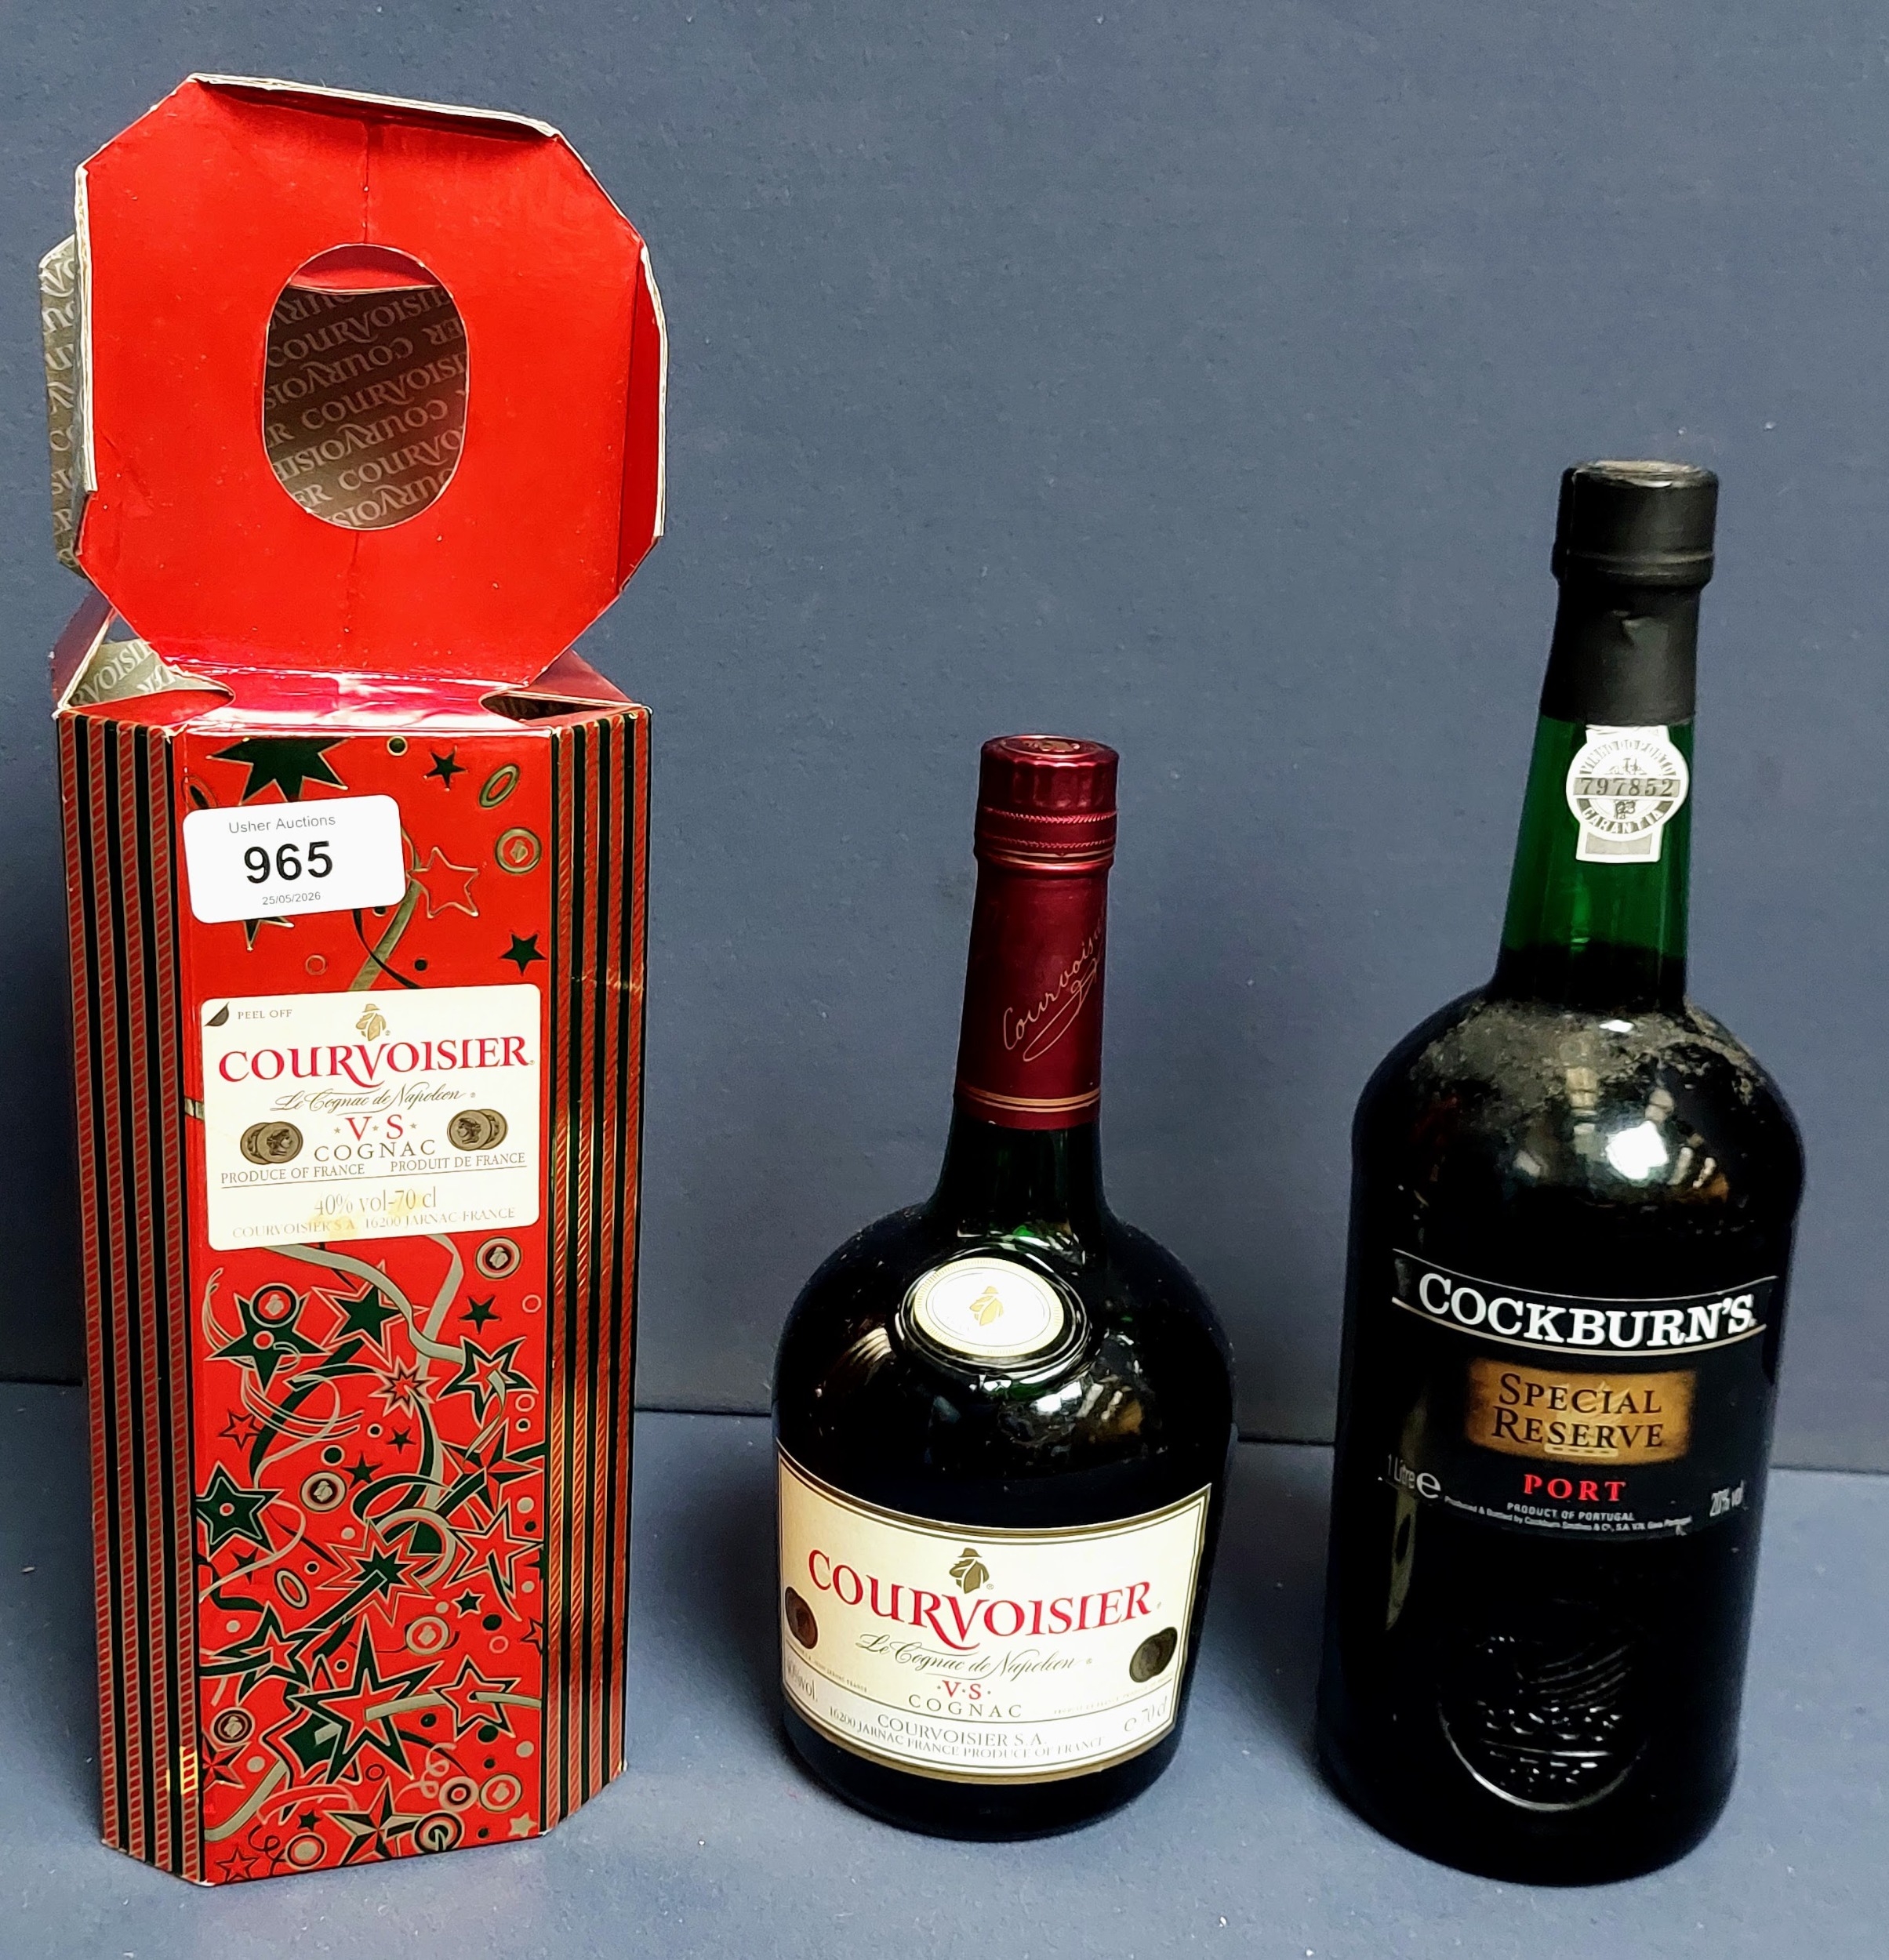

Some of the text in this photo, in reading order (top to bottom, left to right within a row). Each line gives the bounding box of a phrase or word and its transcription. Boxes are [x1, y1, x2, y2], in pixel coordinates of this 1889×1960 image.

[1581, 777, 1673, 797] 797852
[229, 815, 336, 833] Usher Auctions
[244, 840, 333, 884] 965
[262, 891, 321, 906] 25/05/2026
[237, 1009, 293, 1020] PEEL OFF
[219, 1036, 529, 1088] COURVOISIER
[270, 1091, 303, 1112] Le
[308, 1087, 372, 1116] Cognac
[372, 1089, 393, 1105] de
[314, 1139, 436, 1163] COGNAC
[391, 1152, 525, 1173] PRODUIT DE FRANCE
[220, 1163, 365, 1185] PRODUCE OF FRANCE
[314, 1192, 354, 1216] 40%
[421, 1186, 437, 1208] cl
[232, 1221, 330, 1239] COURVOISIER
[365, 1216, 401, 1229] 16200
[1419, 1272, 1755, 1348] COCKBURN'S
[1498, 1372, 1662, 1414] SPECIAL
[1491, 1406, 1664, 1449] RESERVE
[1523, 1474, 1626, 1502] PORT
[1507, 1502, 1636, 1522] PRODUCT OF PORTUGAL
[808, 1549, 1152, 1650] COURVOISIER
[855, 1634, 891, 1654] Le
[890, 1641, 966, 1671] Cognac
[968, 1655, 992, 1672] de
[908, 1694, 1022, 1719] COGNAC
[829, 1706, 1106, 1759] 16200 JARNAC FRANCE PRODUCE OF FRANCE
[877, 1714, 1008, 1747] COURVOISIER
